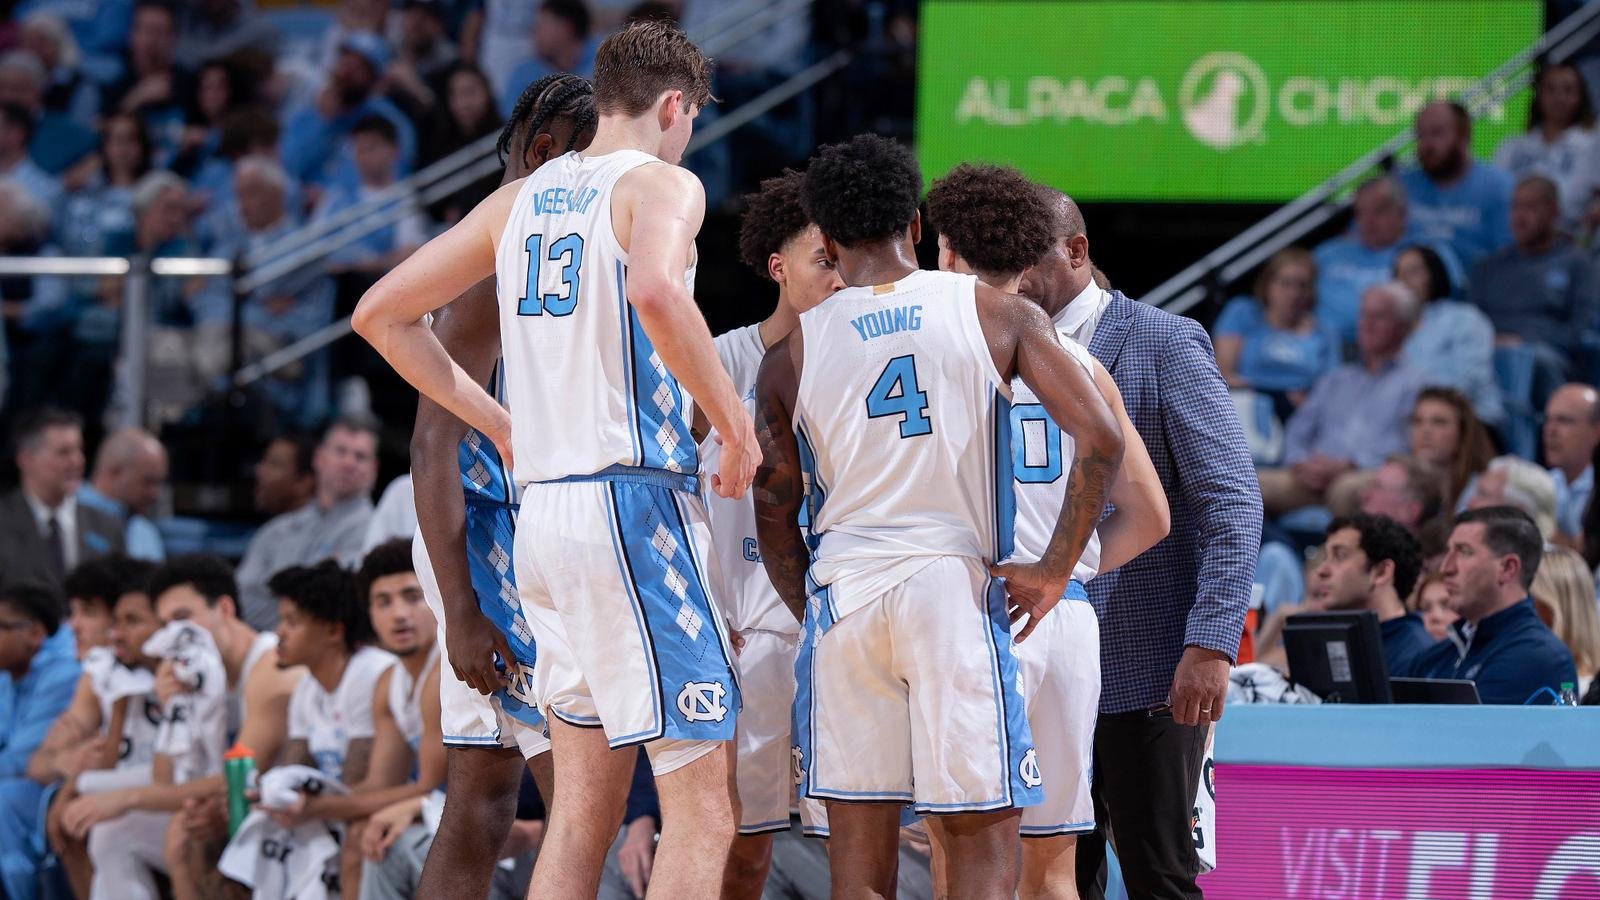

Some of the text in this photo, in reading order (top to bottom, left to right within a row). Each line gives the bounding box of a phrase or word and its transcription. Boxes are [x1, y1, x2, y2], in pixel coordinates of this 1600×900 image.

[956, 76, 1166, 124] ALPACA
[517, 233, 584, 317] 13
[850, 305, 923, 341] YOUNG
[865, 354, 933, 439] 4
[1279, 827, 1404, 900] VISIT
